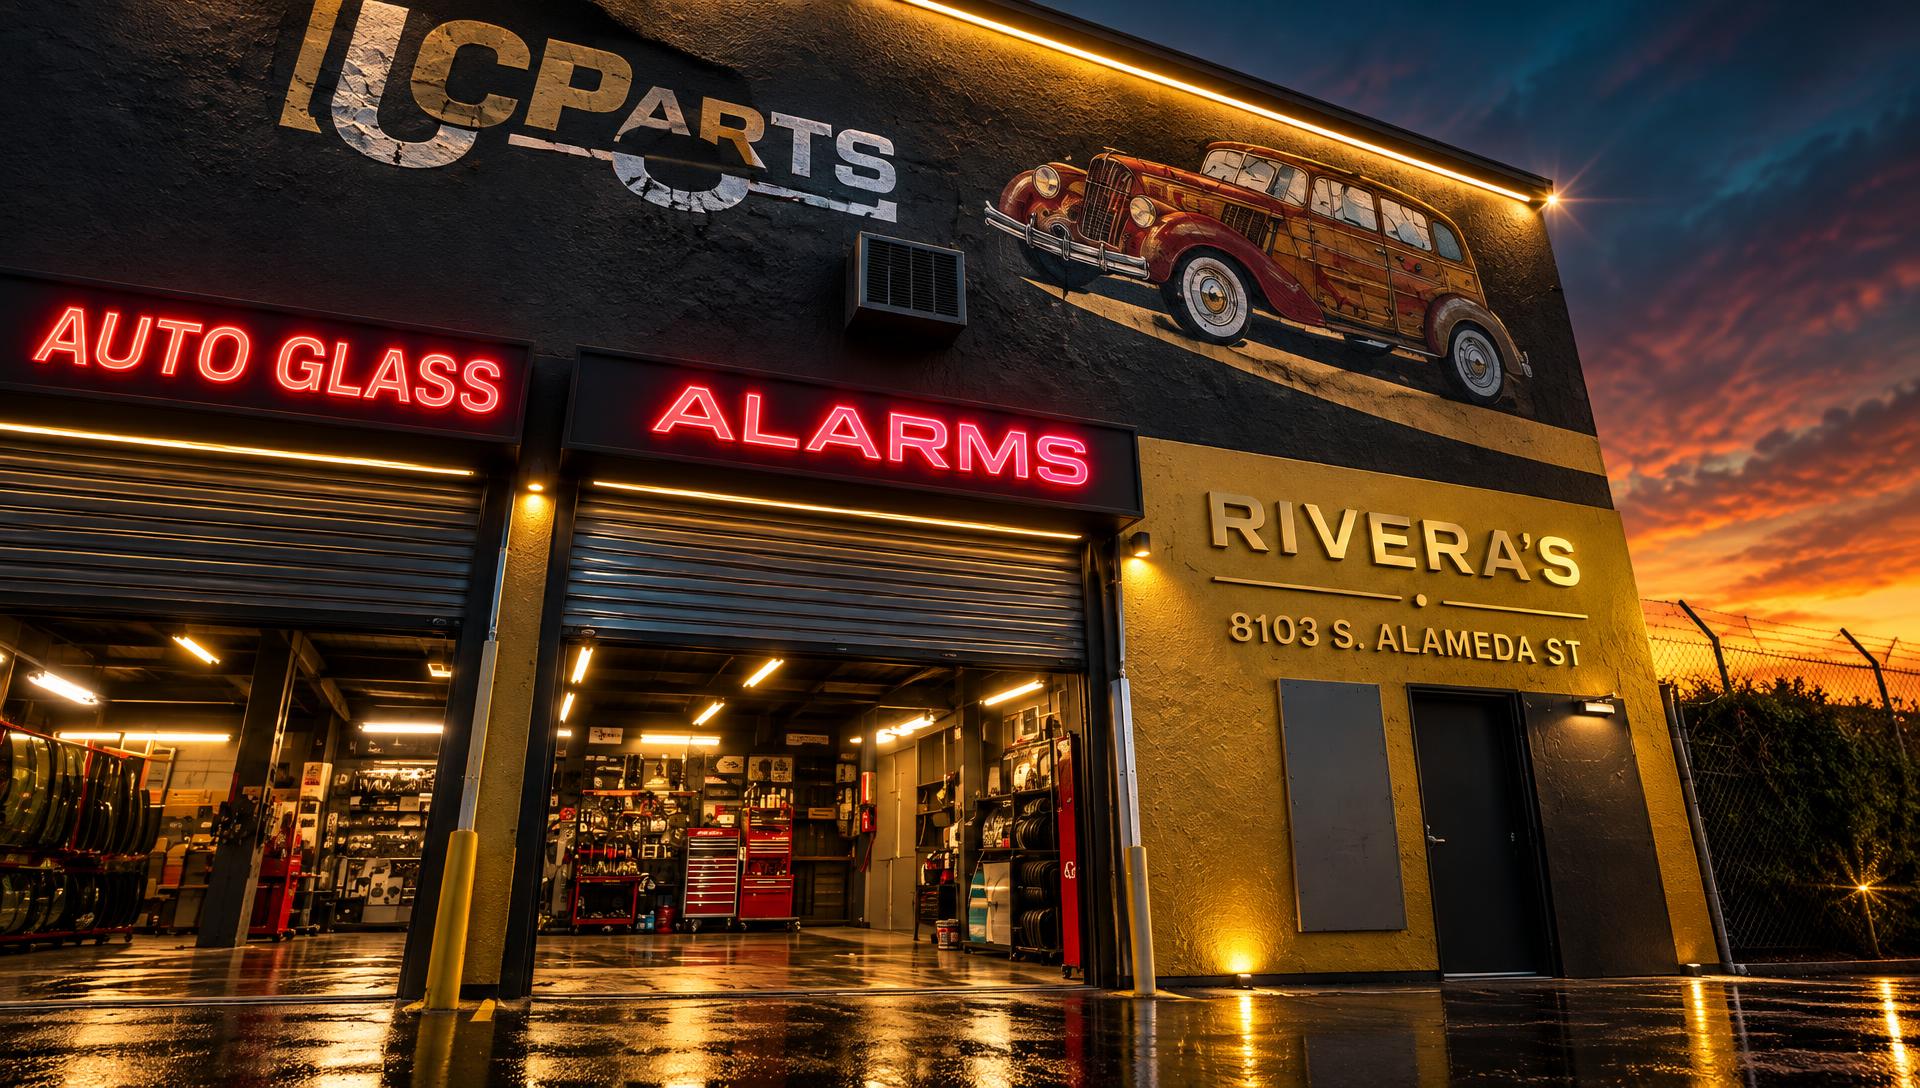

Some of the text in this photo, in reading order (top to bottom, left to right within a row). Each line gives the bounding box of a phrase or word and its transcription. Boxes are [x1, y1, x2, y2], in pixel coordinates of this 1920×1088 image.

[33, 307, 500, 413] AUTO GLASS
[652, 386, 1090, 486] ALARMS
[1207, 490, 1581, 587] RIVERA'S
[1230, 612, 1581, 667] 8103 S. ALAMEDA ST
